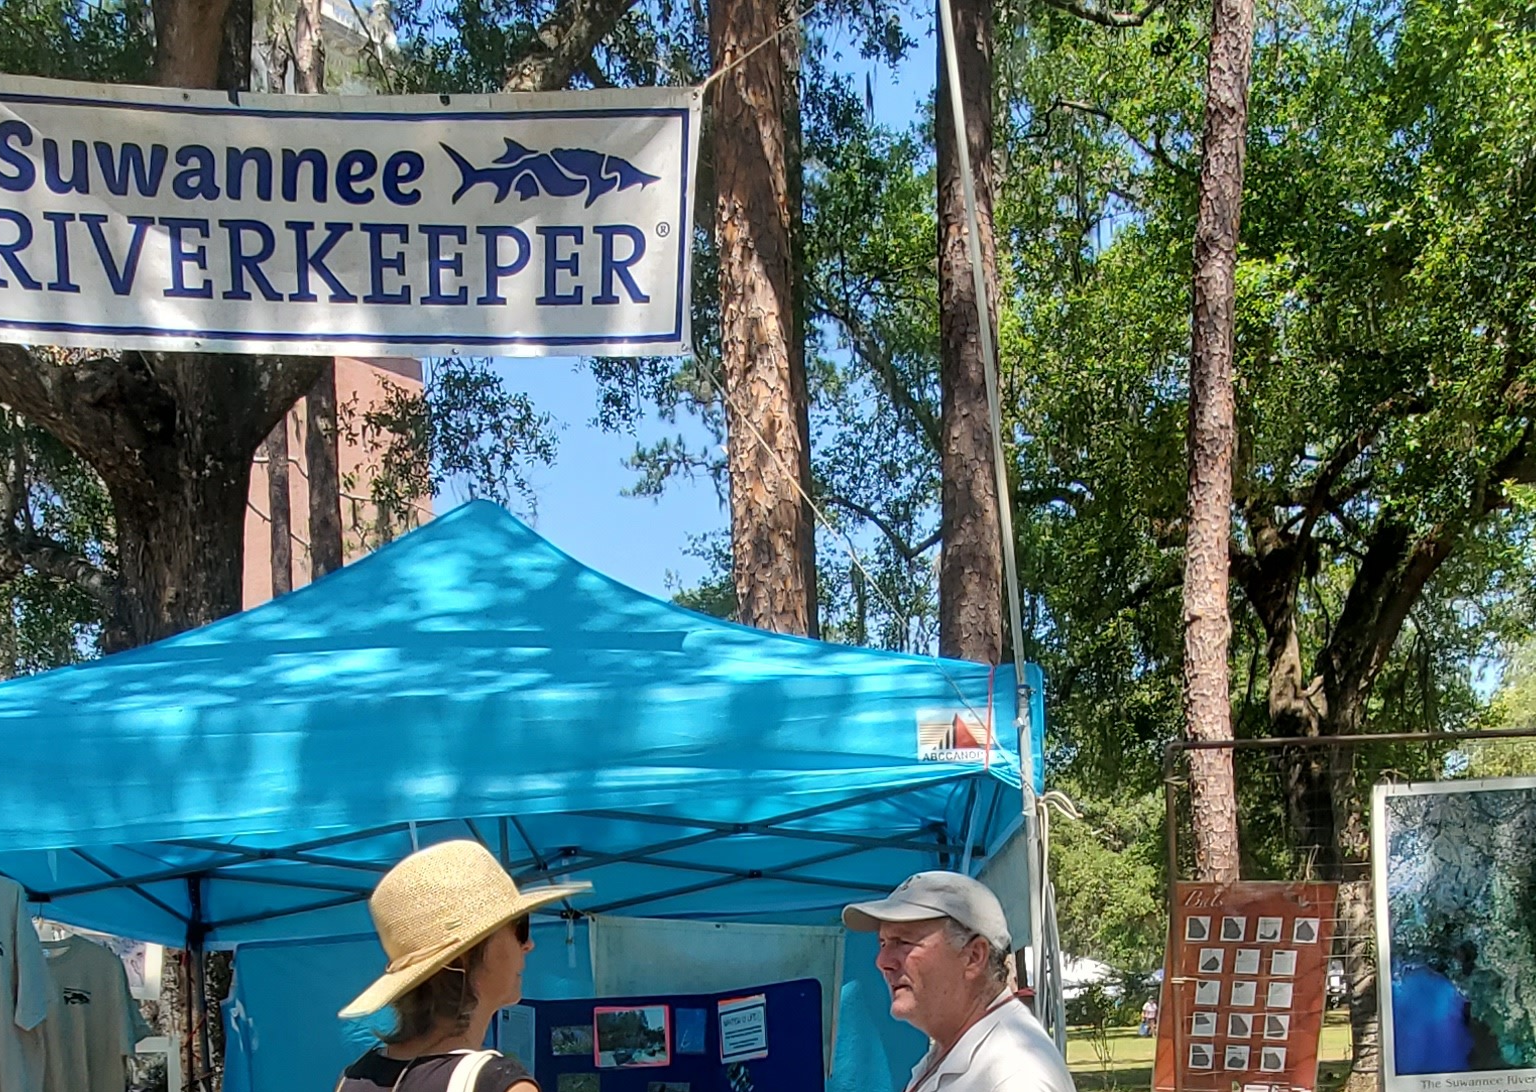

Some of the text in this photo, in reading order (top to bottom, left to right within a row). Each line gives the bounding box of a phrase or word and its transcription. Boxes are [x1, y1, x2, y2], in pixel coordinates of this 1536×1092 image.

[1420, 1079, 1442, 1090] The
[1445, 1077, 1504, 1088] Suwannee
[1507, 1074, 1536, 1086] River
